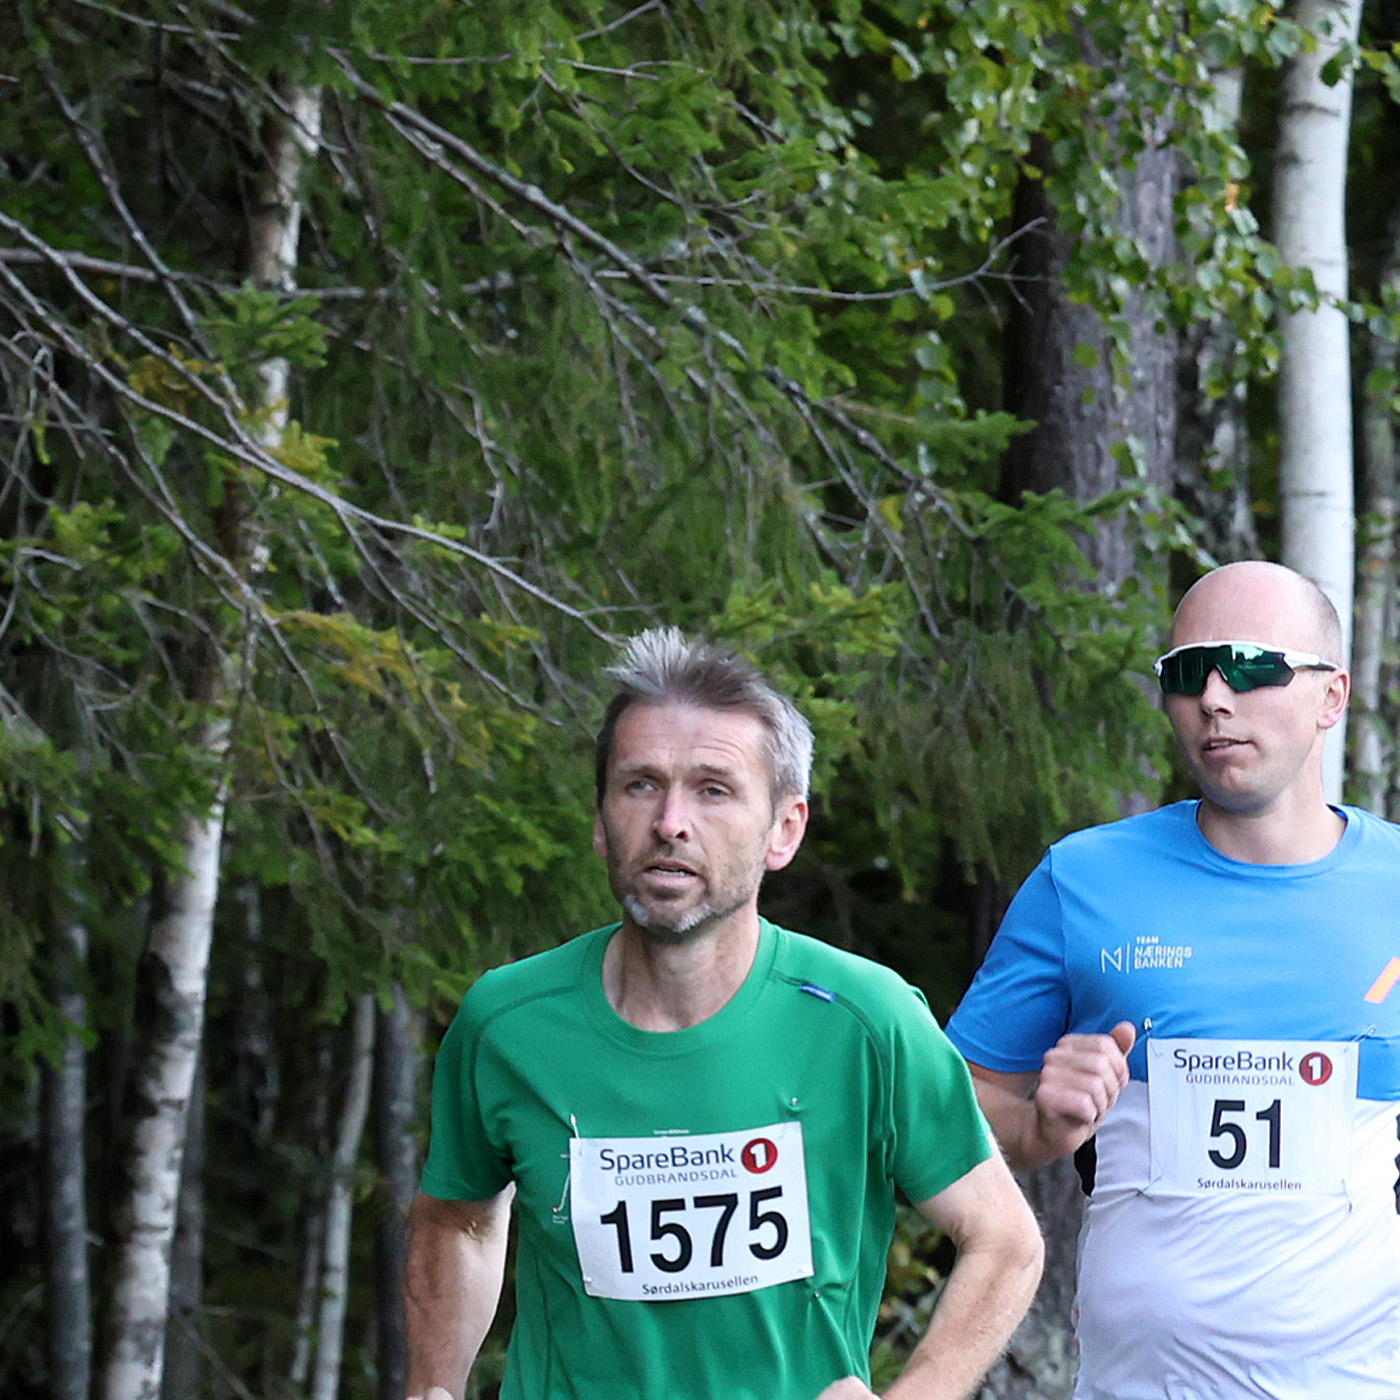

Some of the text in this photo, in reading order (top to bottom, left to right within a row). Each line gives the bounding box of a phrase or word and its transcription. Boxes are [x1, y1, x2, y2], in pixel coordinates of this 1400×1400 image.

[1133, 956, 1185, 970] BANKEN
[1173, 1048, 1294, 1073] SpareBank
[1186, 1072, 1296, 1087] GUDBRANDSDAL
[1207, 1099, 1282, 1170] 51
[600, 1143, 736, 1174] SpareBank
[614, 1168, 738, 1187] GUDBRANDSDAL
[1196, 1177, 1303, 1191] Sørdalskarusellen
[600, 1185, 789, 1274] 1575
[642, 1274, 759, 1296] Sørdalskarusellen
